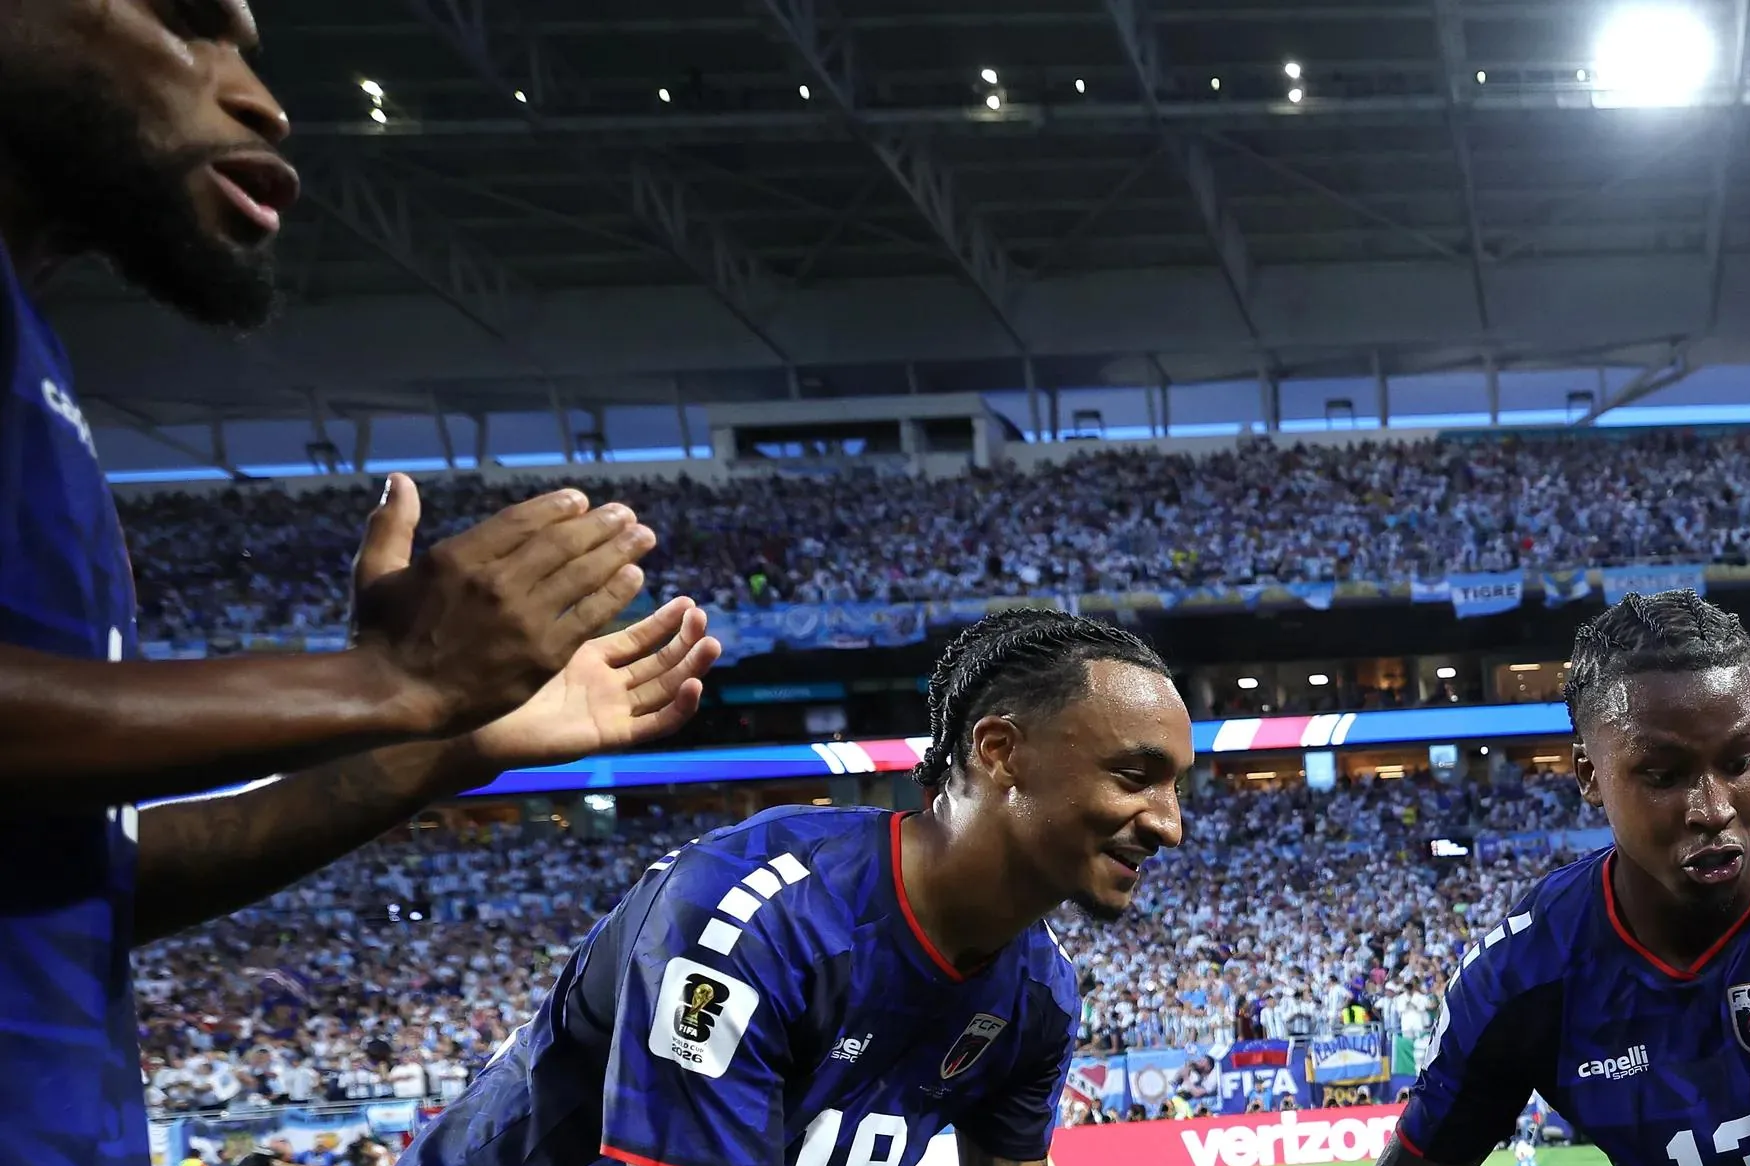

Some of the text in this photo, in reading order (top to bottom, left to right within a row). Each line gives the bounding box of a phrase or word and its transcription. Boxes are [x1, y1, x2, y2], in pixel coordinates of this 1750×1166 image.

[1462, 586, 1518, 600] TIGRE
[678, 1024, 699, 1038] FIFA
[969, 1018, 1002, 1032] FCF
[671, 1043, 703, 1064] 2026
[689, 1044, 705, 1053] CUP
[1577, 1044, 1649, 1079] capelli
[1612, 1063, 1650, 1081] SPORT
[1221, 1068, 1299, 1099] FIFA
